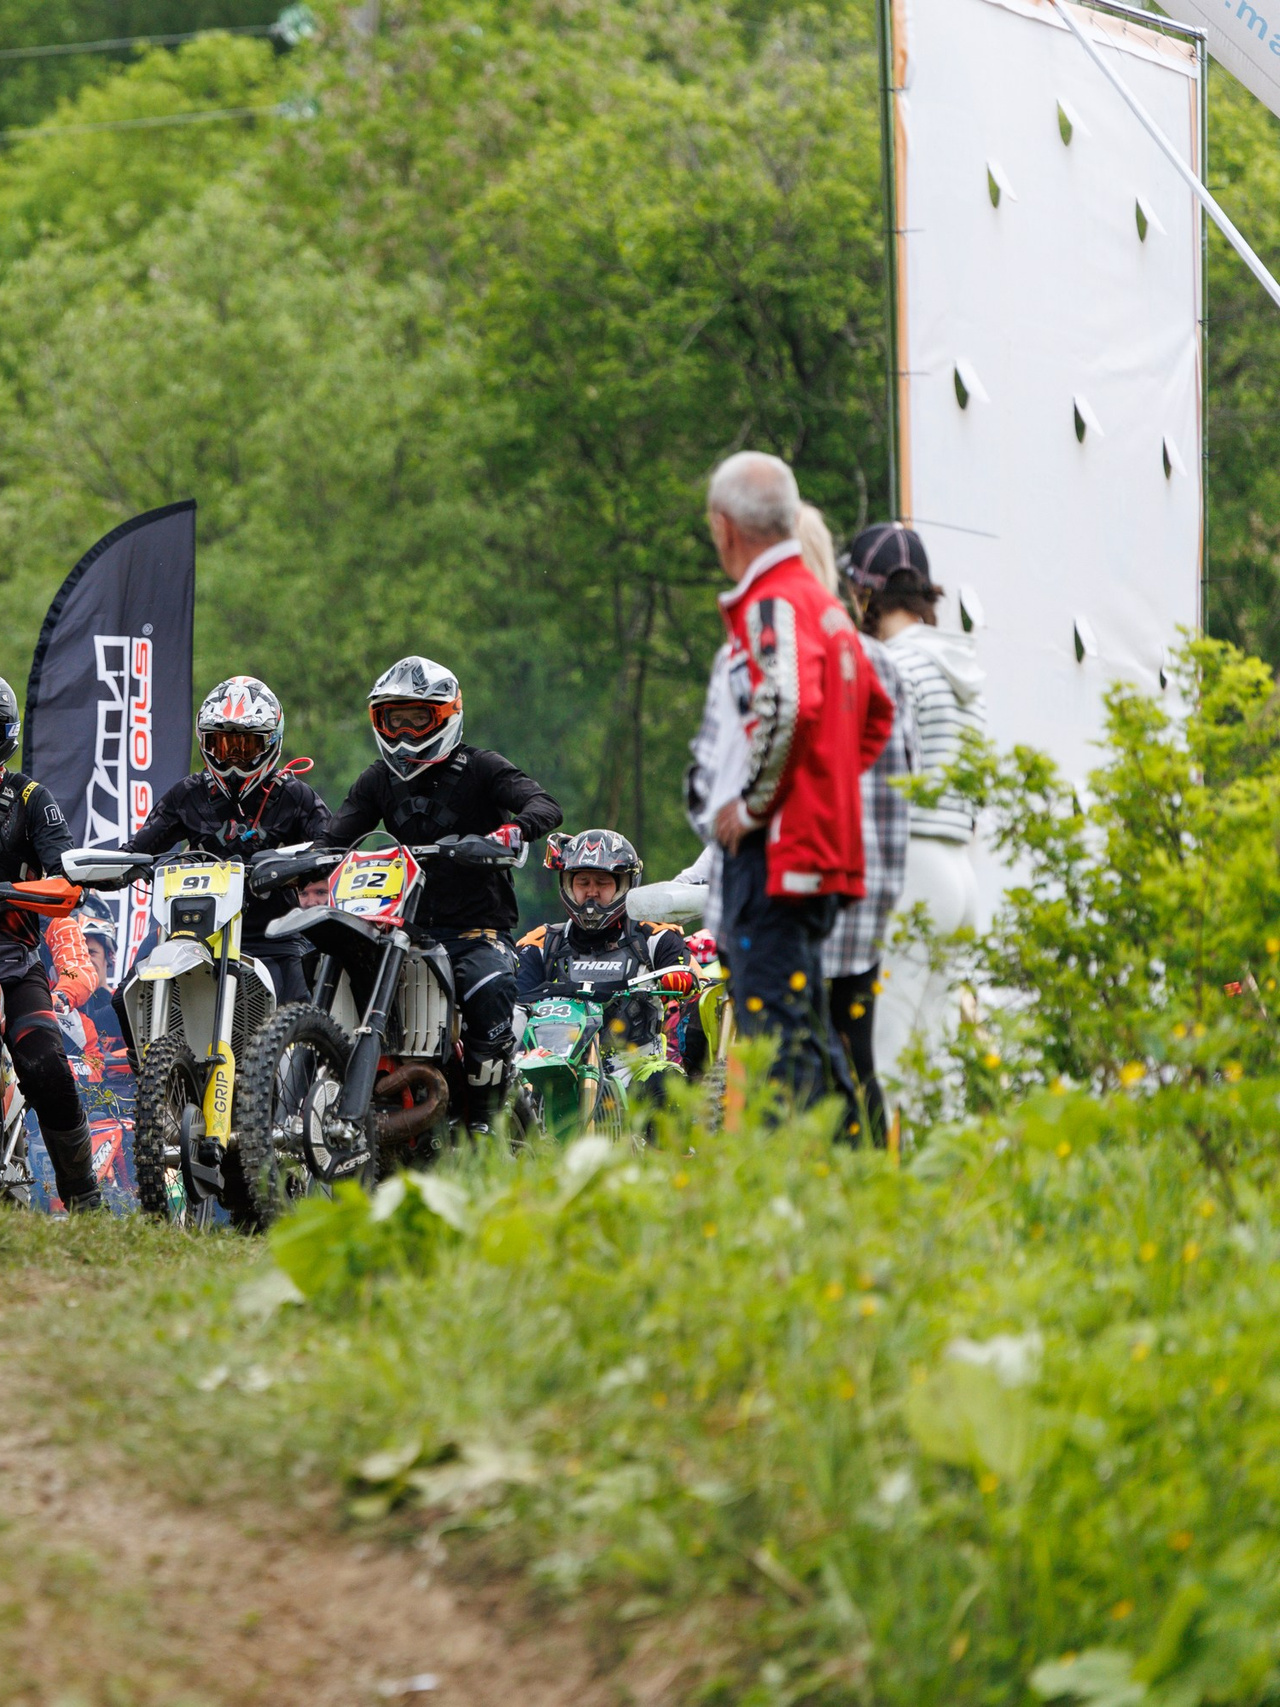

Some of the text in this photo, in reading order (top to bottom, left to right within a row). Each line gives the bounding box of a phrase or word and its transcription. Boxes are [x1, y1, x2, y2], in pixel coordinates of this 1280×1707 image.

[131, 639, 151, 770] OILS
[181, 875, 211, 892] 91
[350, 872, 388, 891] 92
[572, 961, 622, 970] THOR
[537, 1004, 571, 1018] 84
[213, 1071, 229, 1132] X-GRIP
